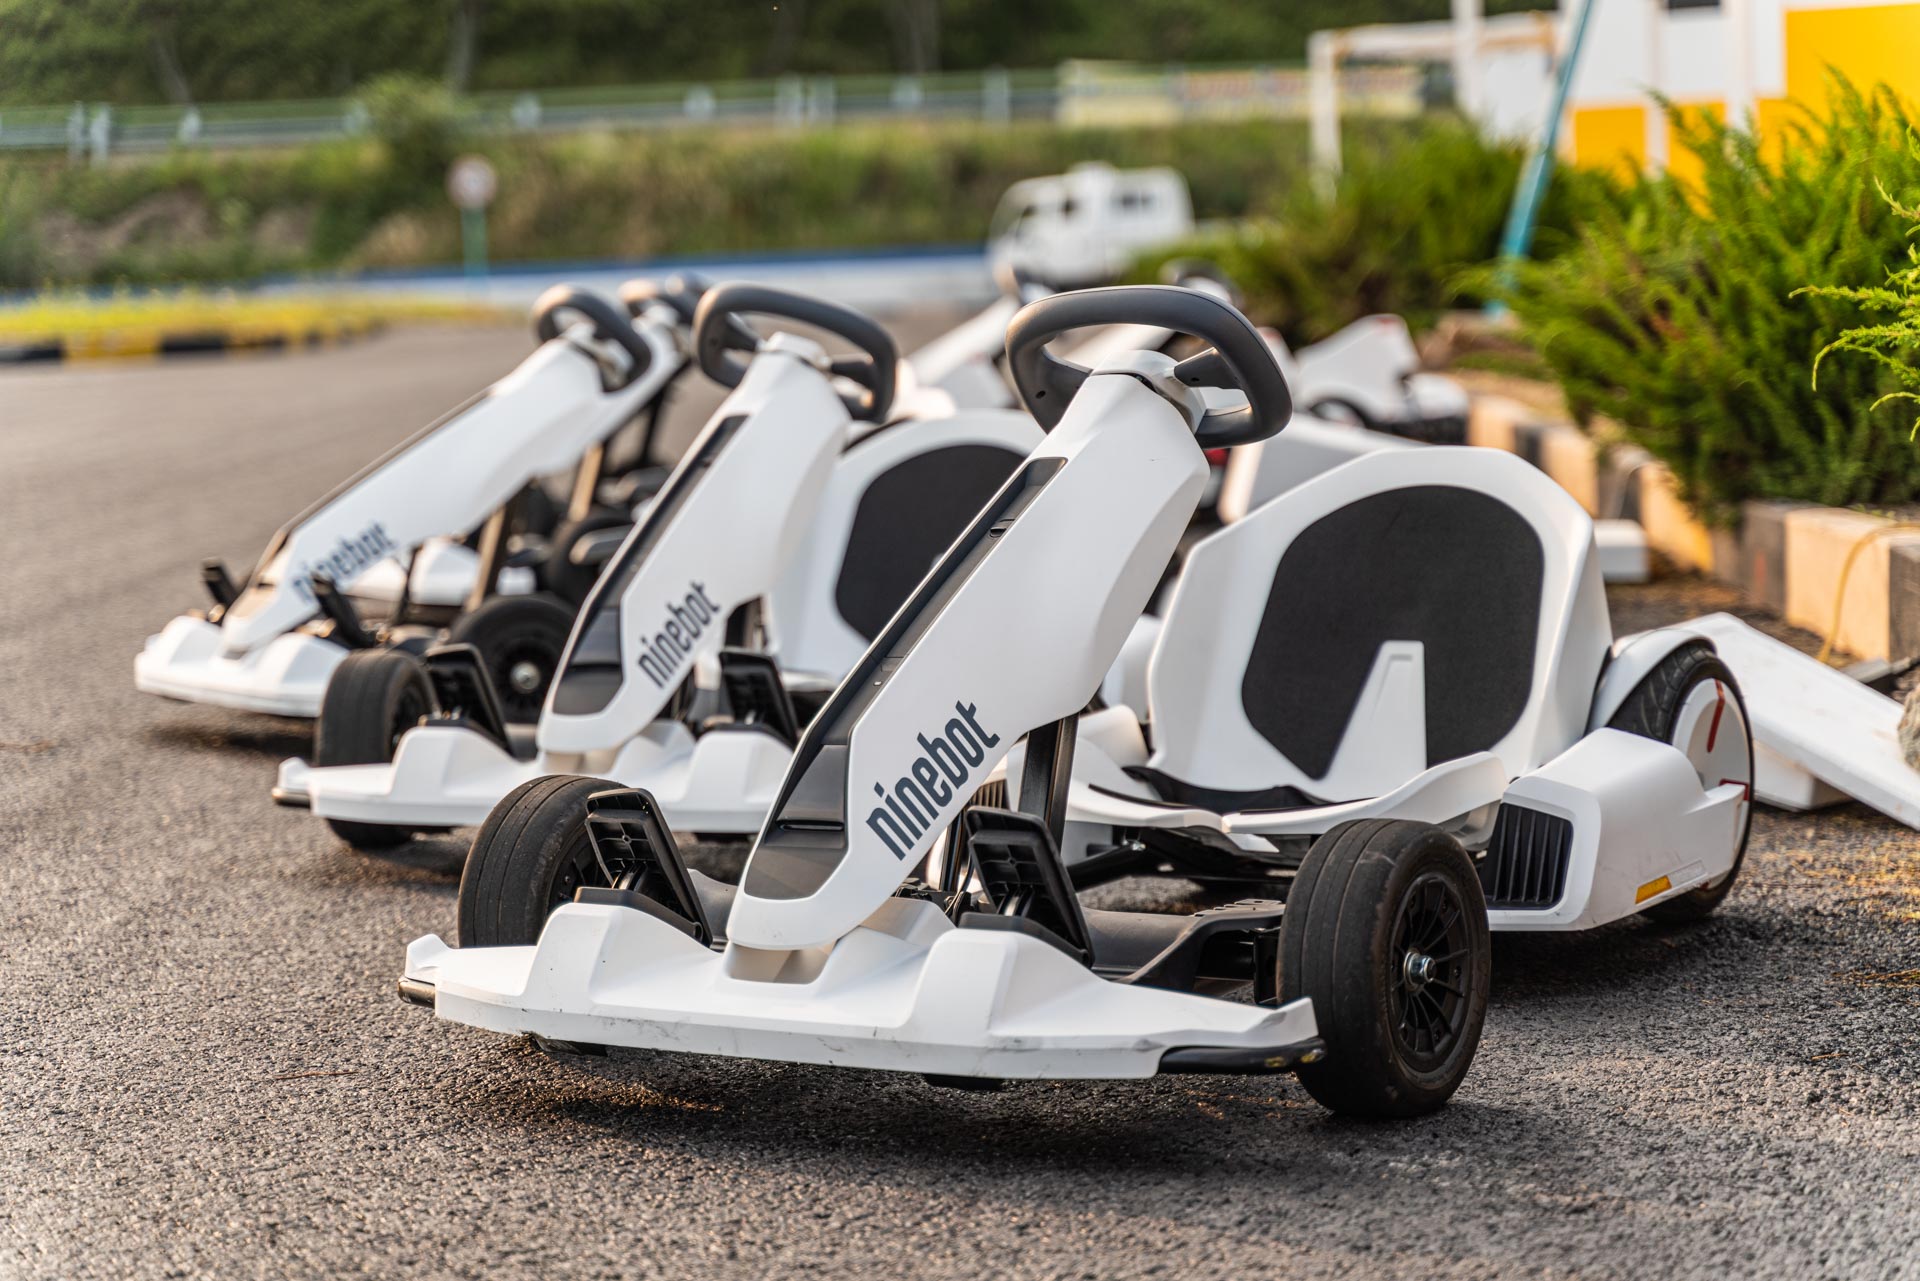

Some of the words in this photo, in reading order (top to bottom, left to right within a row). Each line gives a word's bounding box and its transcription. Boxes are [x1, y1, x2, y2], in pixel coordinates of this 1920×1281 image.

[293, 521, 396, 606] nnebot
[638, 581, 720, 689] ninebot
[866, 700, 1000, 861] ninebot
